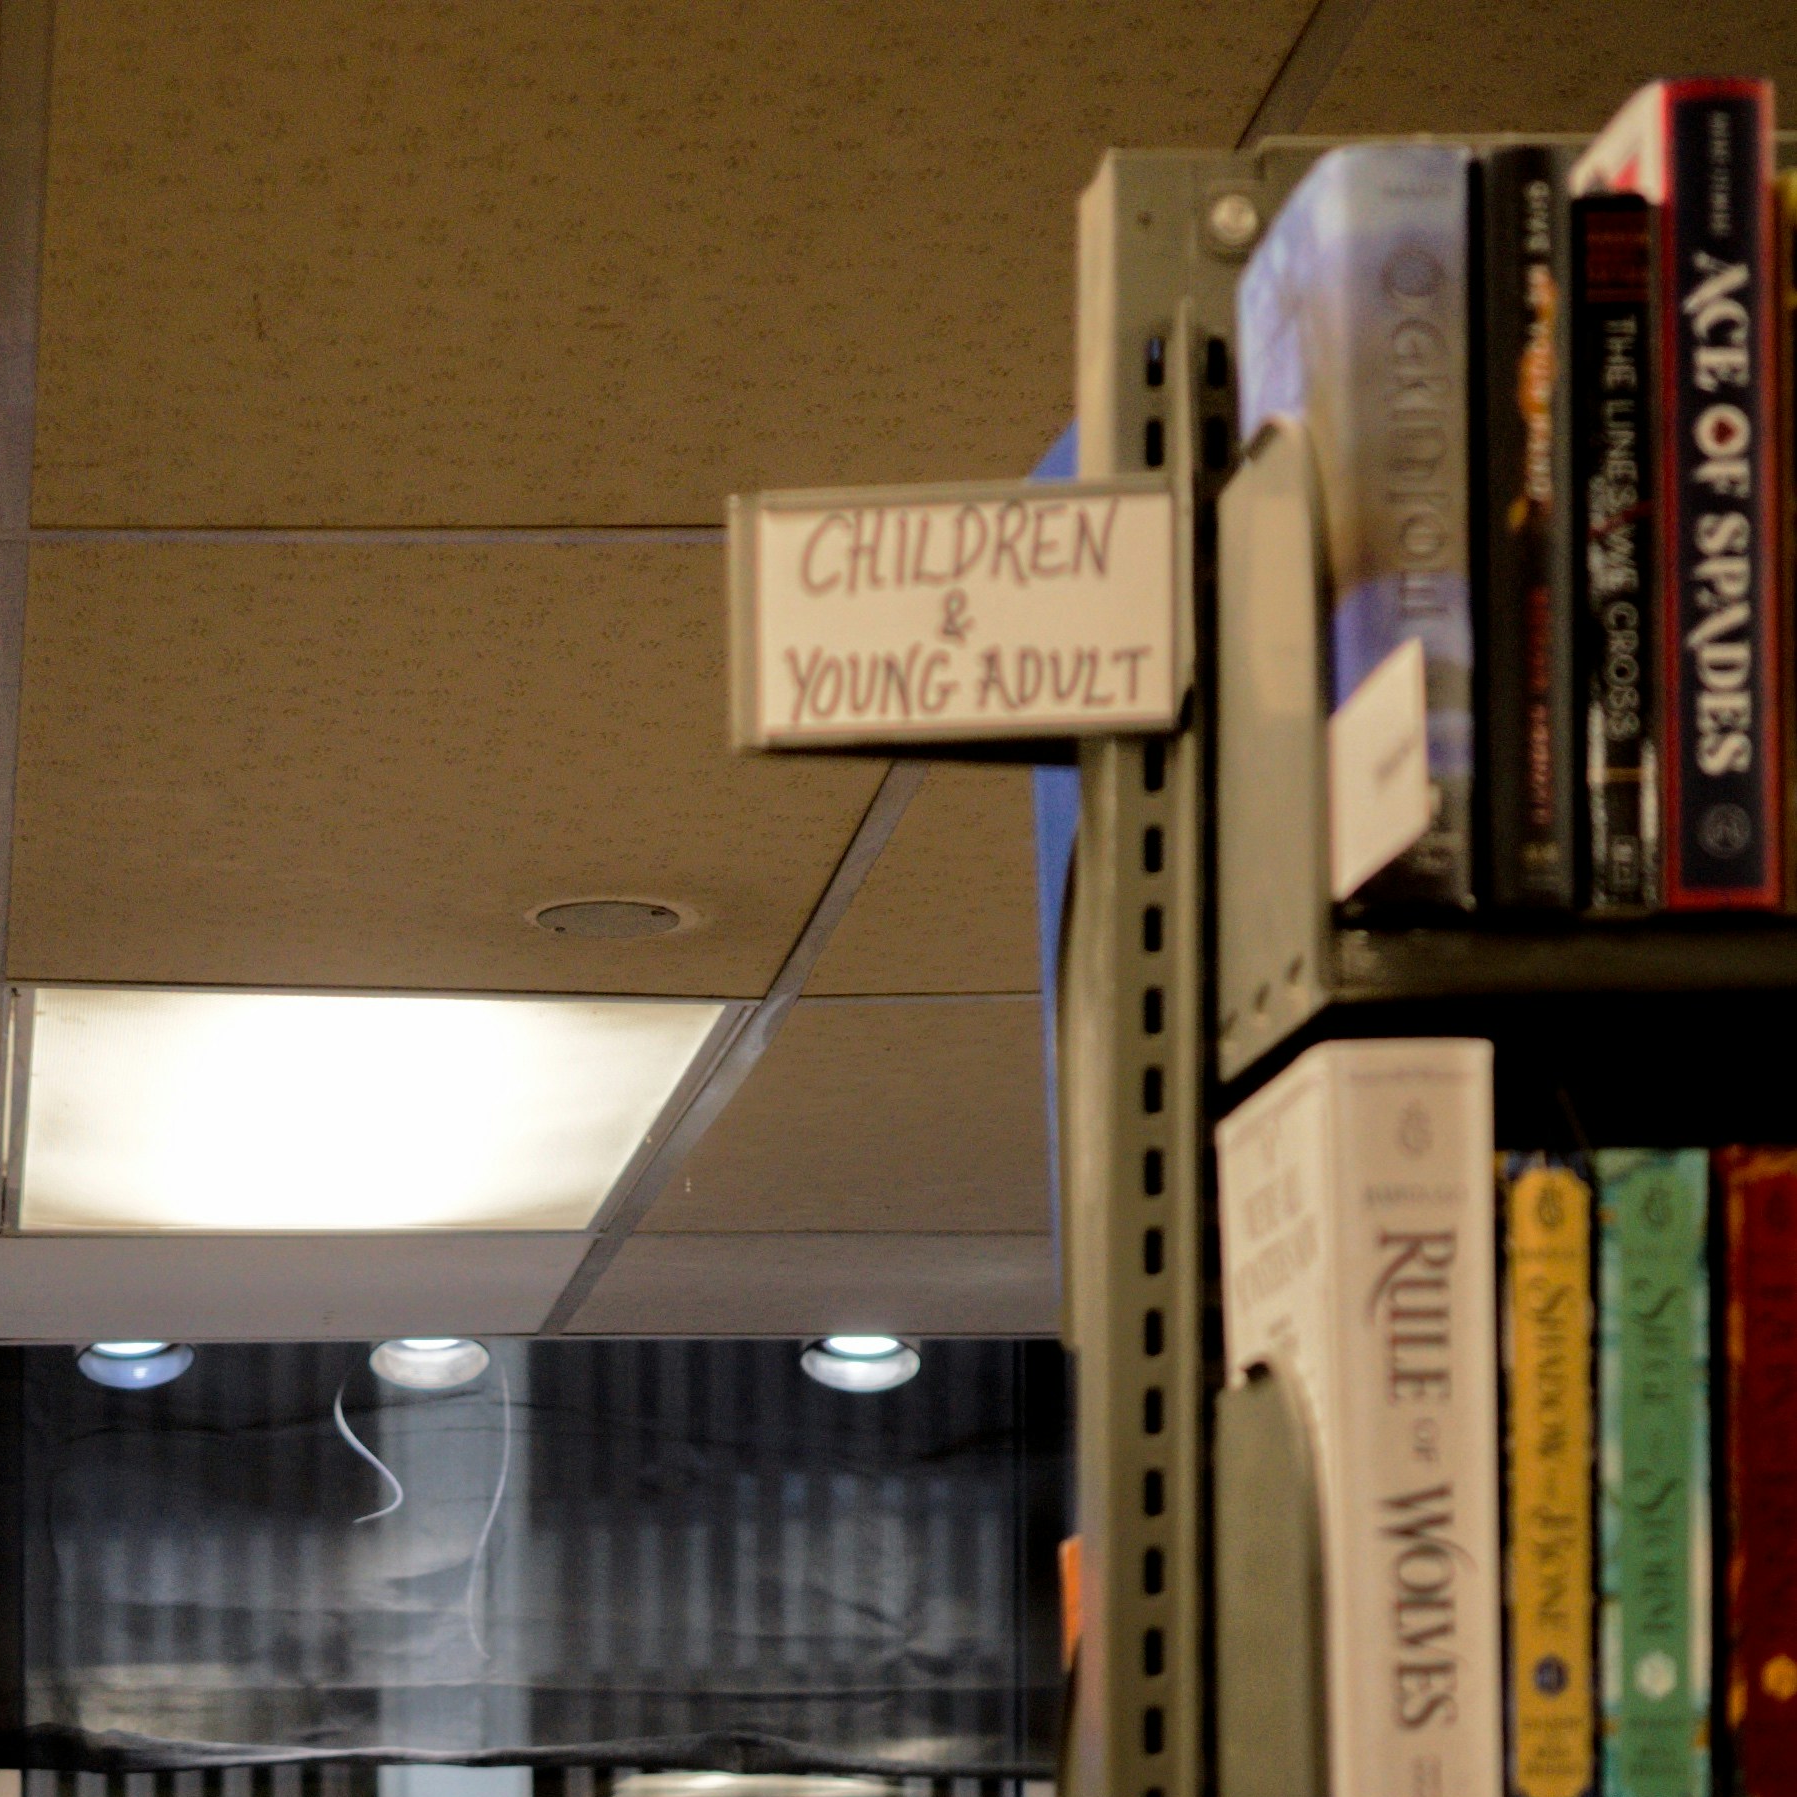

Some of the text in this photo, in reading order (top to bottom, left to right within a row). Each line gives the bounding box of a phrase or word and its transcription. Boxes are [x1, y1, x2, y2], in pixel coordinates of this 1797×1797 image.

[1524, 178, 1550, 254] GIVE
[1604, 313, 1639, 384] THE
[1682, 248, 1755, 397] ACE
[1602, 397, 1639, 501] LINES
[1693, 400, 1754, 500] OF
[801, 497, 1120, 598] CHILDREN
[1603, 524, 1640, 589] WE
[940, 588, 975, 645] &
[1603, 600, 1640, 742] CROSS
[1686, 509, 1755, 780] SPADES
[783, 642, 1153, 725] YOUNG ADULT
[1366, 1227, 1459, 1406] RULE
[1521, 1272, 1579, 1466] SHADOW
[1625, 1276, 1687, 1408] SIEGE
[1411, 1414, 1441, 1463] OF
[1377, 1483, 1476, 1734] WOLVES
[1525, 1496, 1581, 1634] BONE
[1619, 1467, 1691, 1637] STORM
